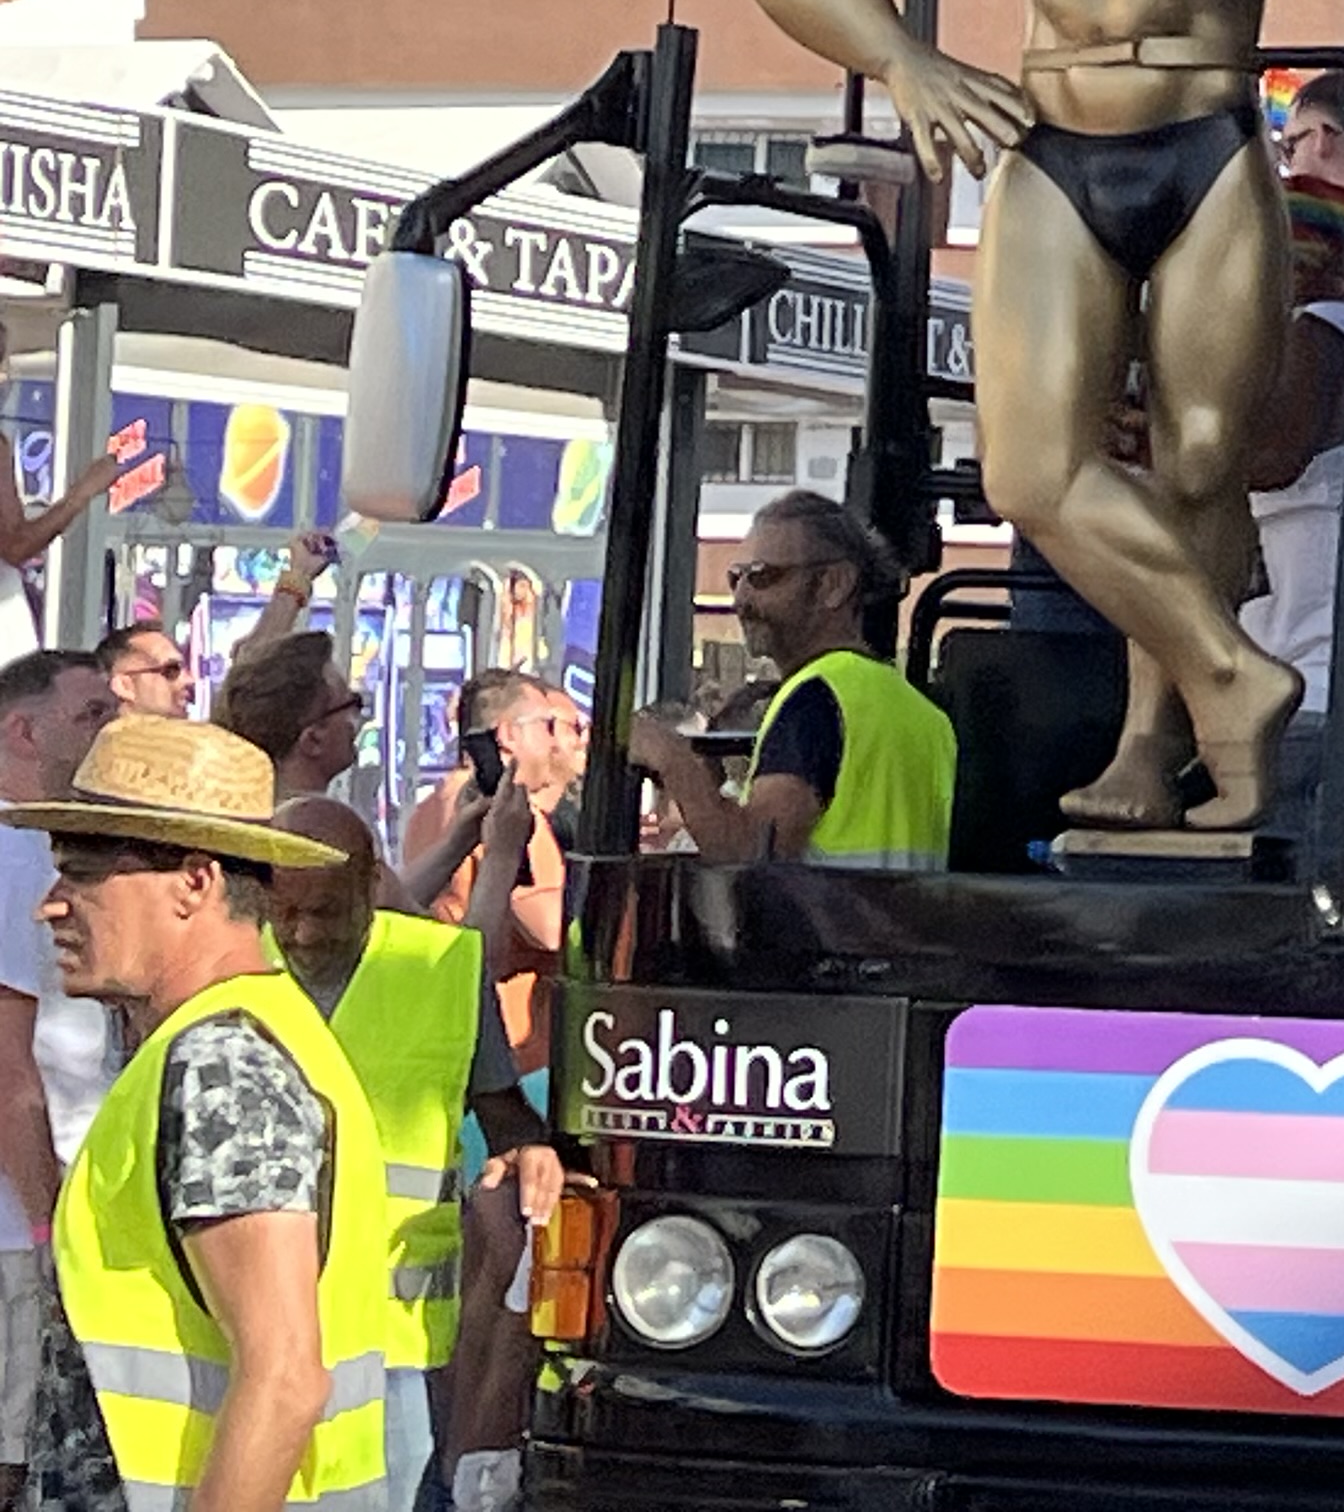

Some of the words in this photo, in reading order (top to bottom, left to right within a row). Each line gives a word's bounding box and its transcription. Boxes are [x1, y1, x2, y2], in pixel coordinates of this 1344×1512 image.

[0, 142, 137, 231] ISHA
[247, 181, 398, 259] CAF
[444, 217, 494, 287] &
[582, 1008, 832, 1112] Sabina
